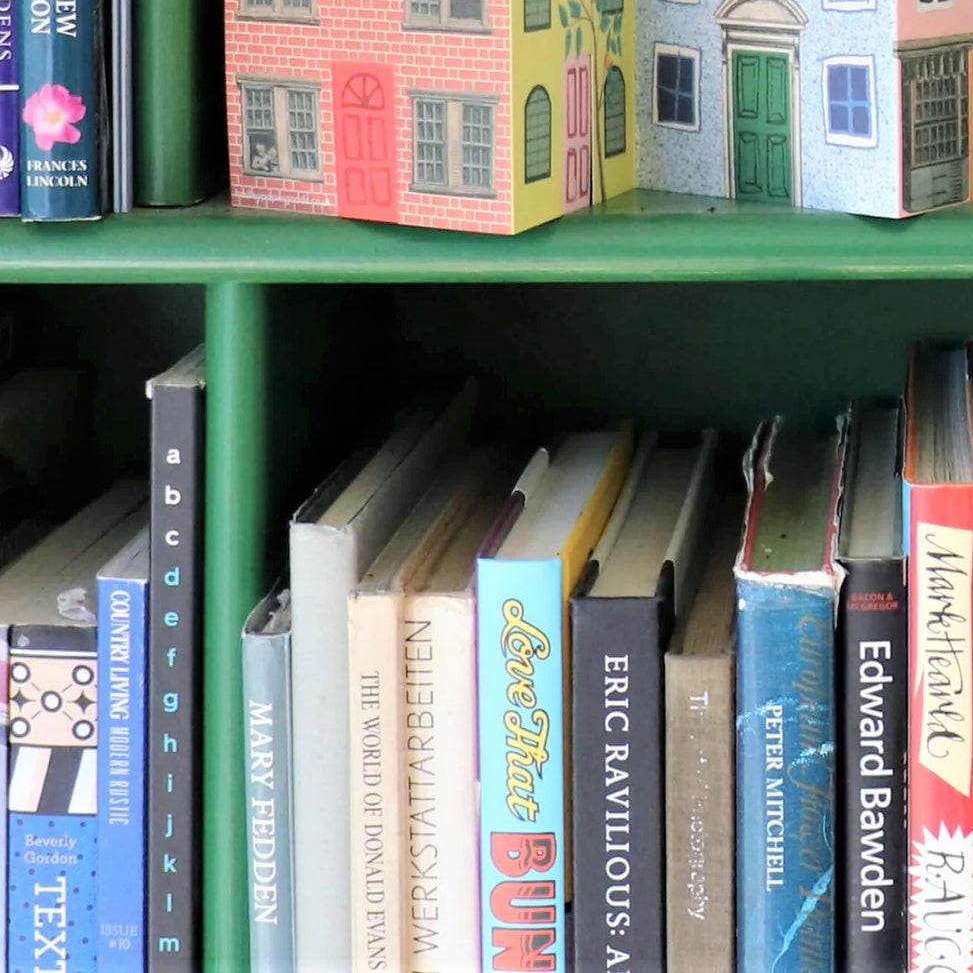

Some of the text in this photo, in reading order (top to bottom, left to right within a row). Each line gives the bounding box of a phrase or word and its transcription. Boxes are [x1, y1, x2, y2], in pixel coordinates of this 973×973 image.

[25, 158, 89, 172] FRANCES
[25, 174, 89, 187] LINCOLN
[167, 448, 180, 464] a
[164, 485, 181, 505] b
[164, 530, 179, 546] c
[164, 566, 180, 587] d
[925, 534, 969, 633] Mark
[164, 611, 179, 627] e
[166, 647, 176, 667] f
[500, 599, 551, 709] Love
[163, 691, 179, 713] g
[604, 653, 630, 732] ERIC
[108, 589, 131, 825] COUNTRY LIVING MODERN RUSTIC
[163, 732, 178, 753] h
[503, 709, 551, 823] That
[404, 620, 439, 955] WERKSTATTARBEITEN
[859, 639, 895, 932] Edward Bawden
[765, 705, 786, 892] PETER MITCHELL
[249, 698, 279, 925] MARY FEDDEN
[361, 671, 387, 972] THE WORLD OF DONALD EVANS
[165, 812, 173, 838] j
[24, 833, 78, 850] Beverly
[604, 743, 631, 937] RAVILIOUS:
[23, 850, 79, 866] Gordon
[163, 852, 177, 873] k
[101, 924, 139, 937] ISSUE
[158, 936, 181, 952] m
